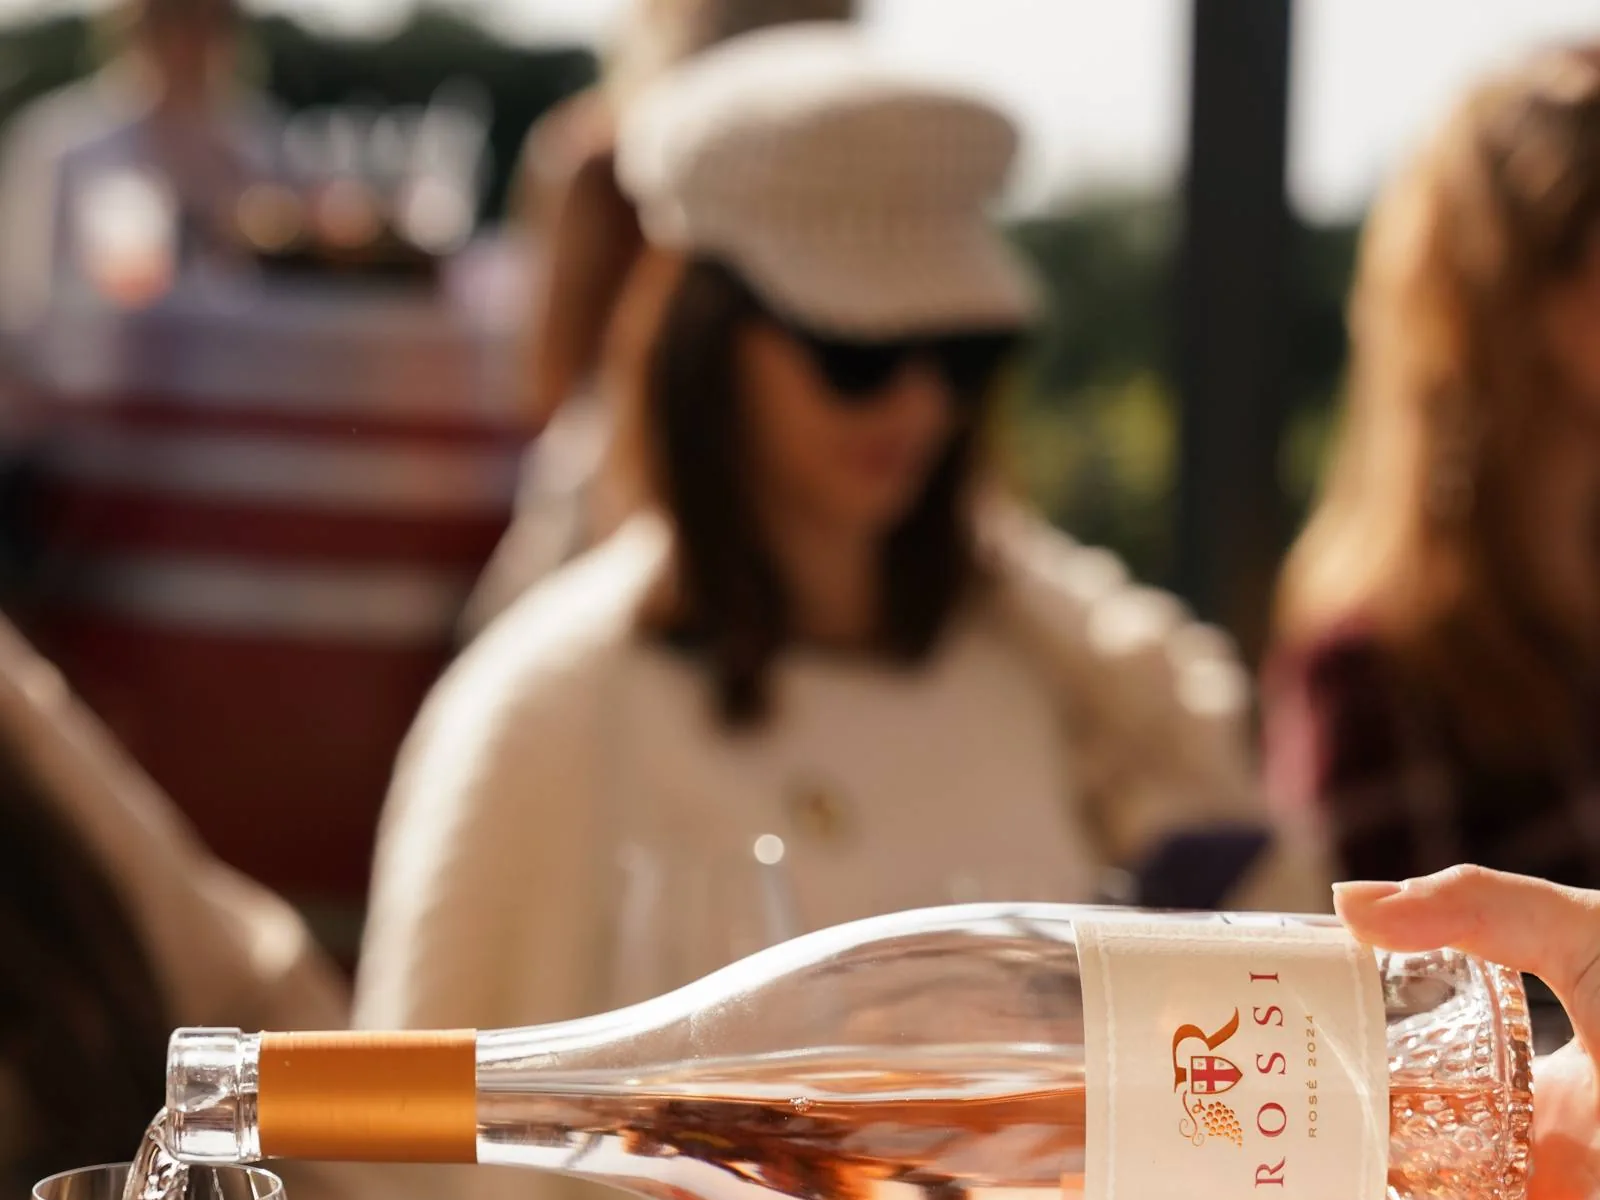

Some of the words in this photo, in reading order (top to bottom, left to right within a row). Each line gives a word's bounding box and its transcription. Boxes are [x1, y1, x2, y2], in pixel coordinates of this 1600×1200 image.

[1172, 1006, 1240, 1094] R
[1305, 1014, 1317, 1067] 2024
[1249, 971, 1287, 1188] ROSSI
[1305, 1078, 1318, 1139] ROSÉ
